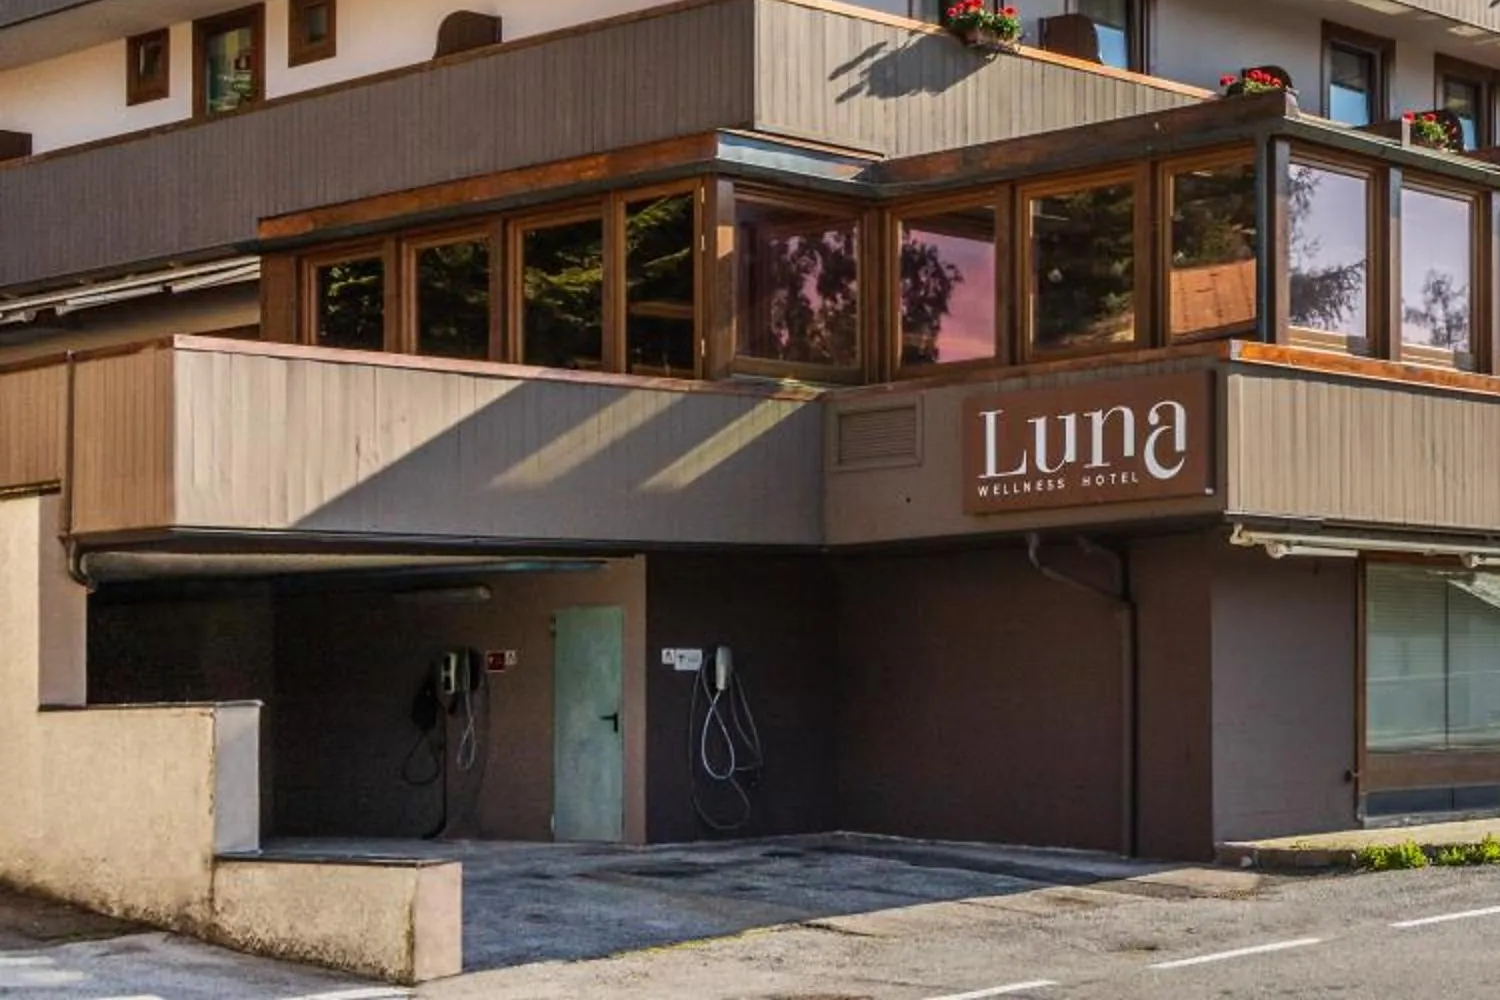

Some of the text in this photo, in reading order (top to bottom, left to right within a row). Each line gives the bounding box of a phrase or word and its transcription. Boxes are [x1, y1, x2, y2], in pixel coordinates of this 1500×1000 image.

[977, 400, 1187, 480] Luna
[977, 471, 1139, 497] WELLNESS HOTEL
